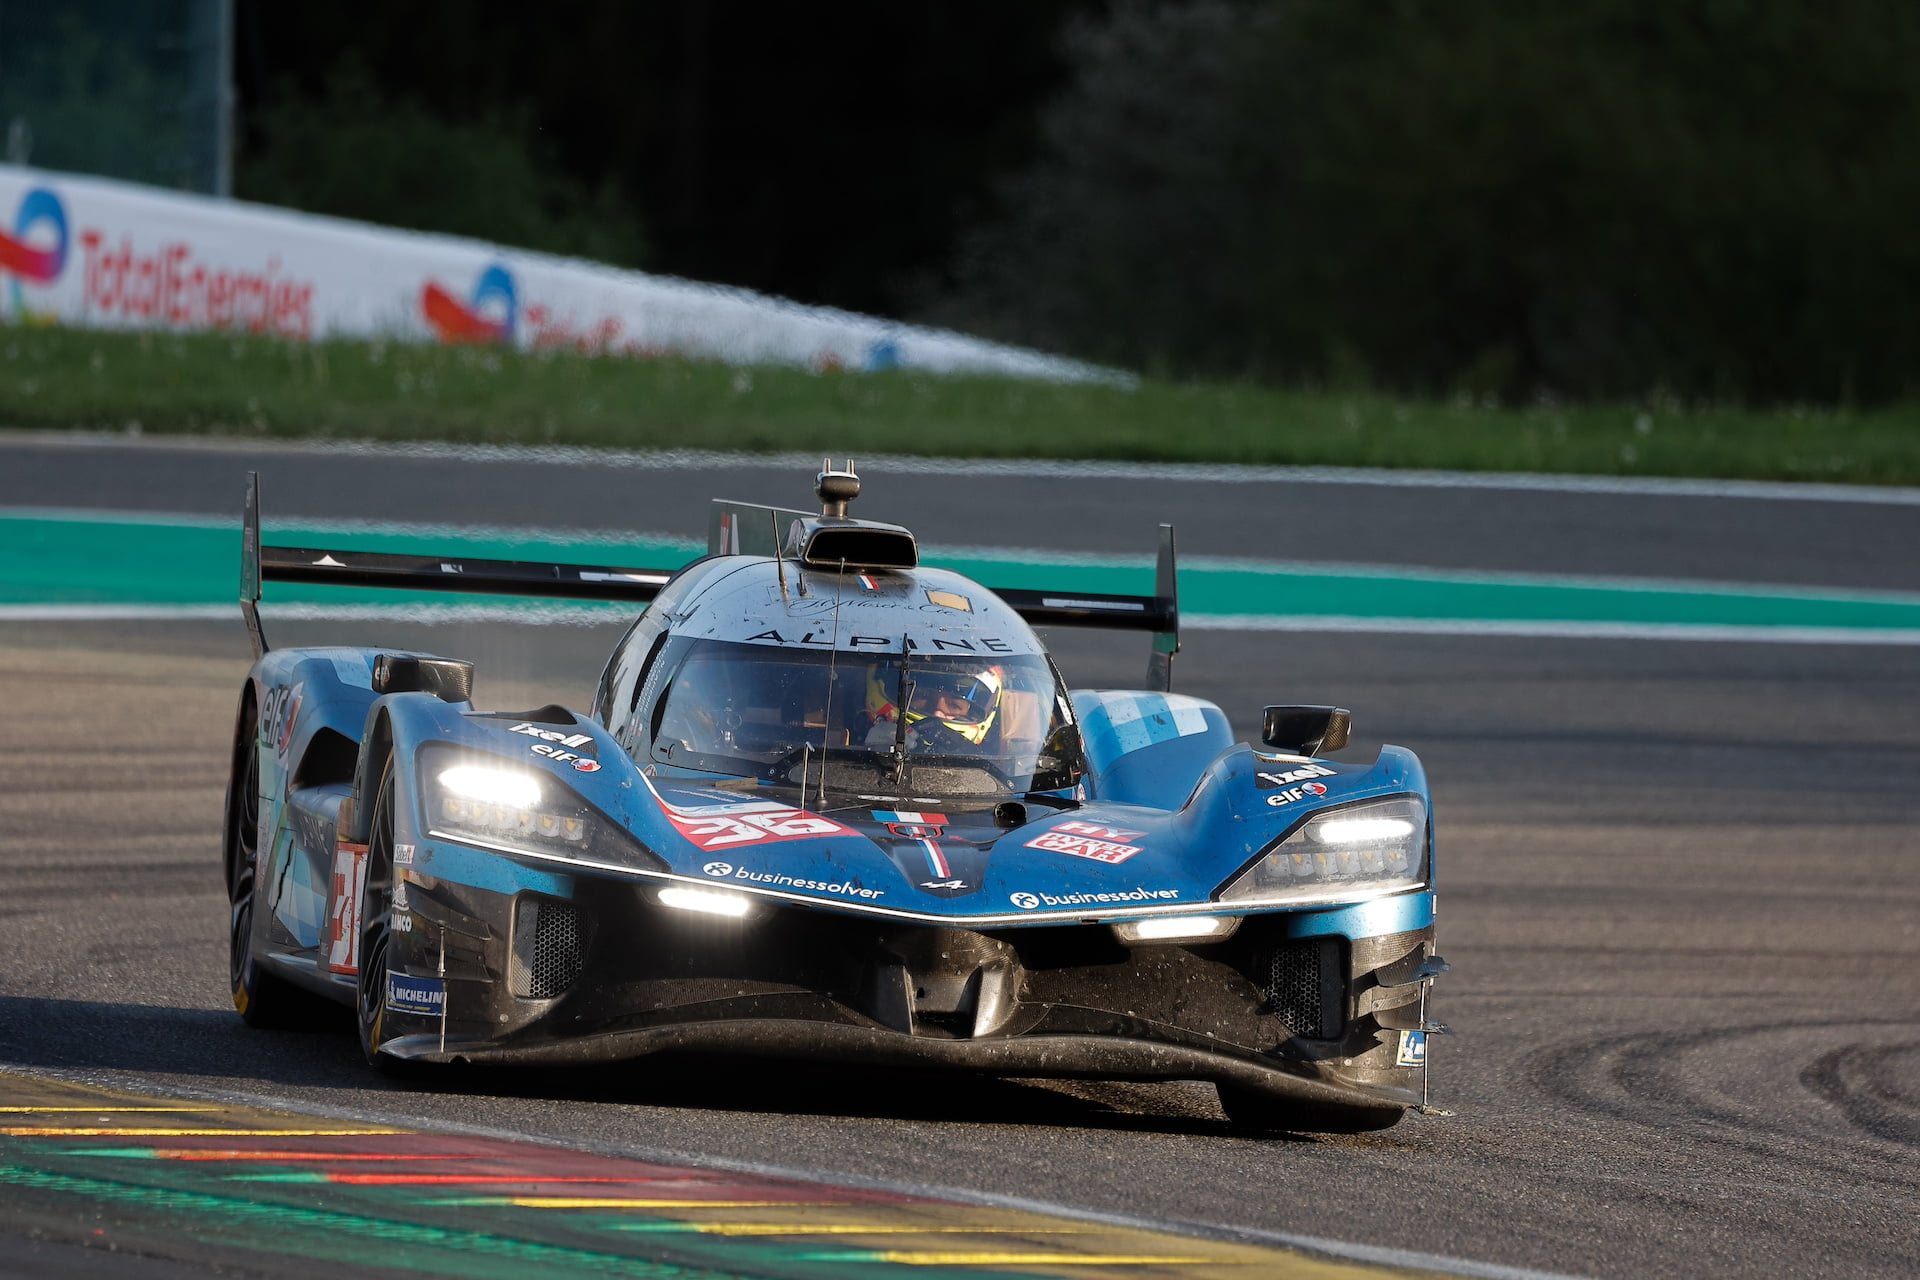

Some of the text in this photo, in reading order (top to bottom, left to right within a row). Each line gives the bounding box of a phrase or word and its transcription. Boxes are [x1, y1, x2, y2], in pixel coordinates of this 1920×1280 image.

[746, 629, 1013, 652] ALPINE
[508, 723, 593, 748] ixell
[1257, 764, 1338, 785] ixell
[668, 811, 842, 846] 36
[1036, 840, 1122, 861] CAR
[735, 866, 884, 899] businessolver
[1040, 887, 1178, 906] businessolver
[396, 988, 444, 1004] MICHELIN
